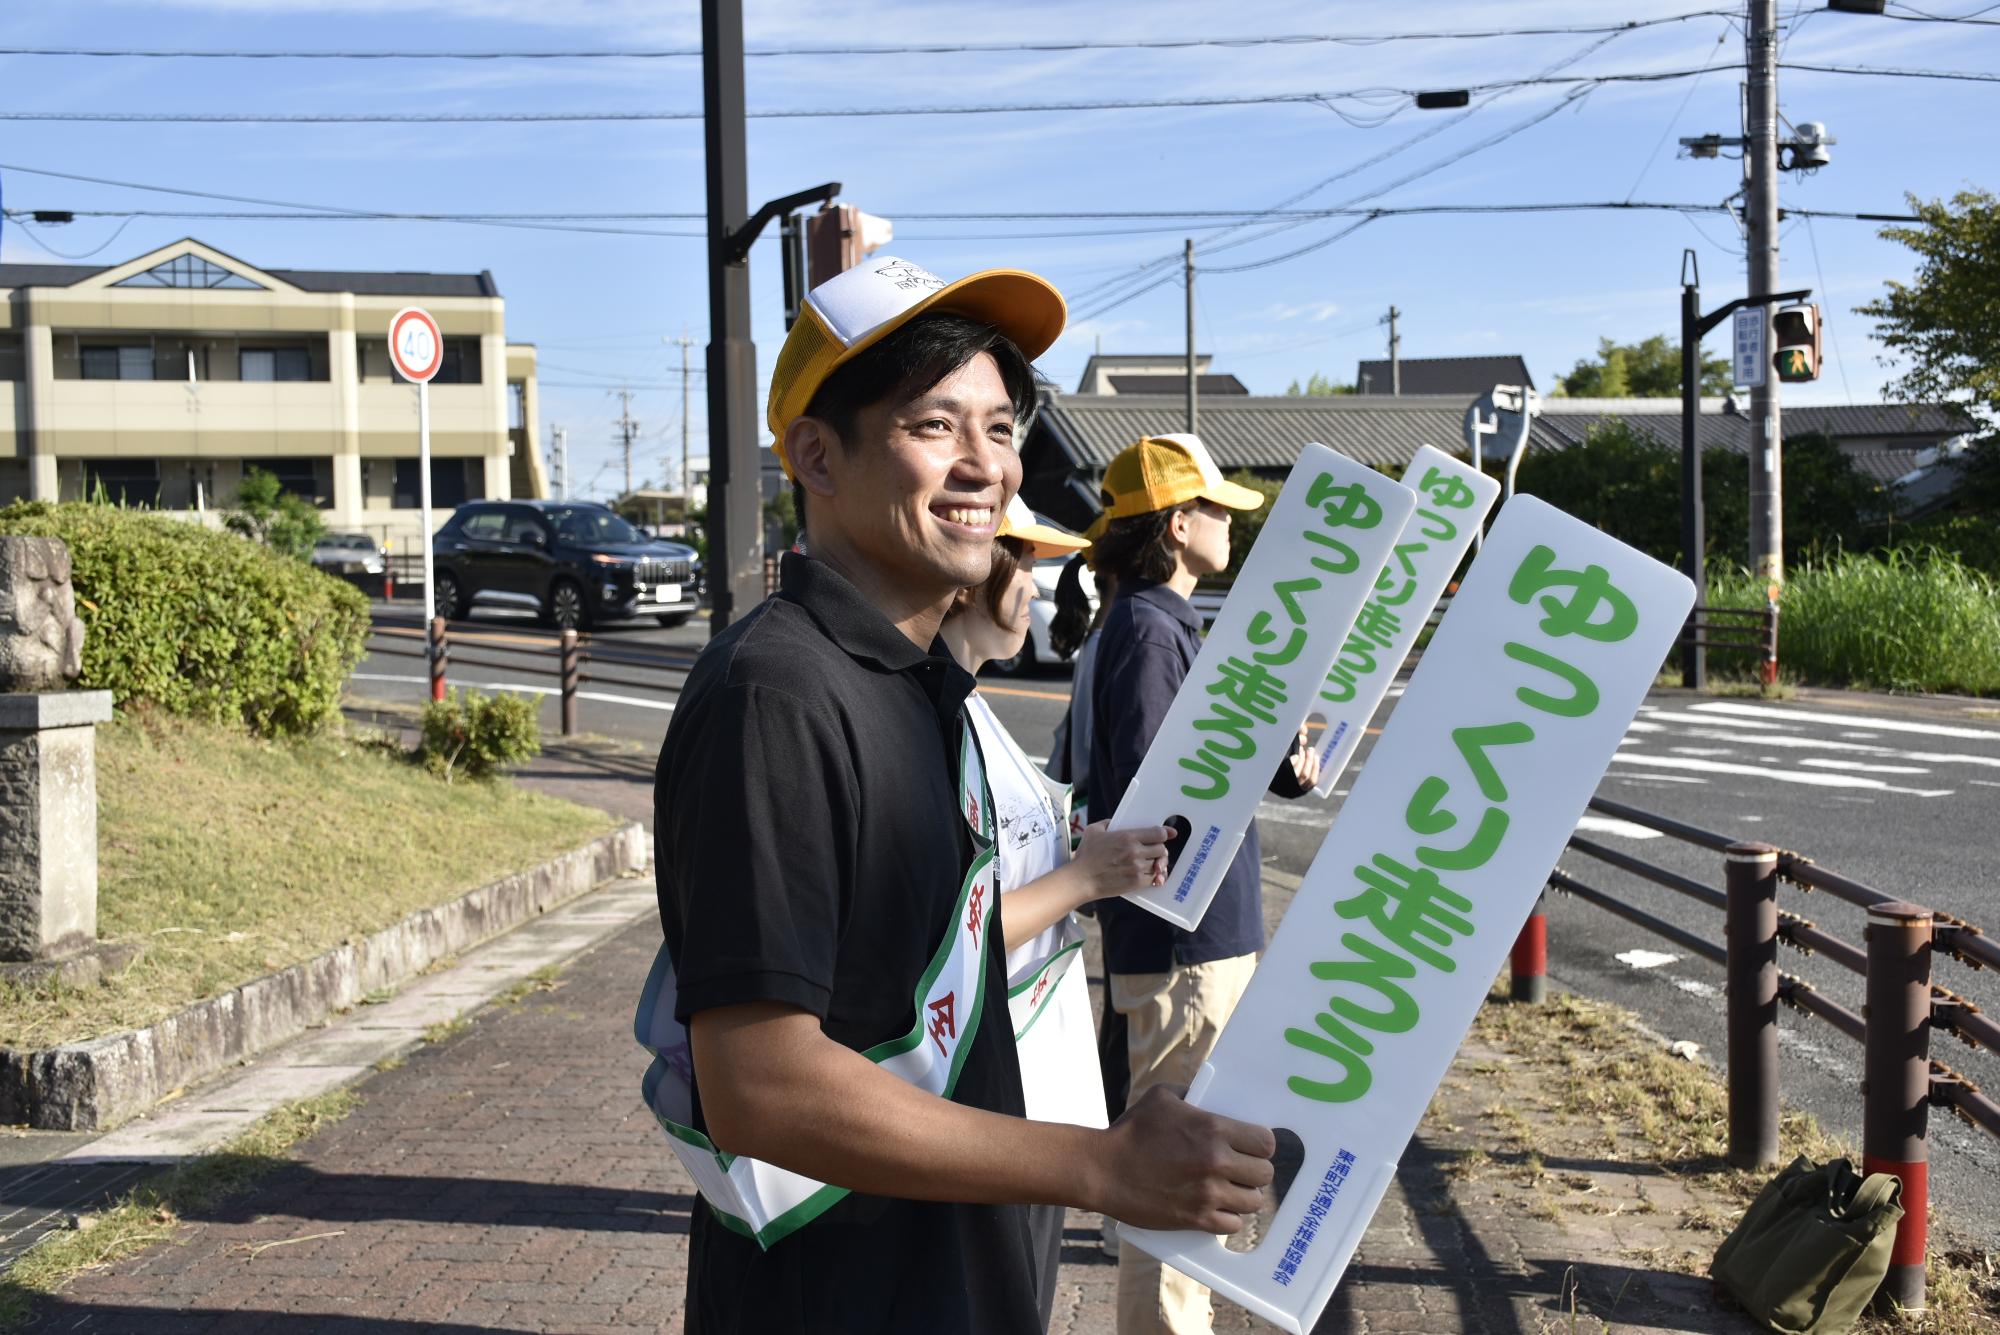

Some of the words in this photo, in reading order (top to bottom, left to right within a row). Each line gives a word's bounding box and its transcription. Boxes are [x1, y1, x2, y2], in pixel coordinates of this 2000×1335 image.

[403, 331, 430, 360] 40
[1180, 472, 1383, 801] ゆっくり走ろう
[1286, 545, 1638, 1103] ゆっくり走ろう
